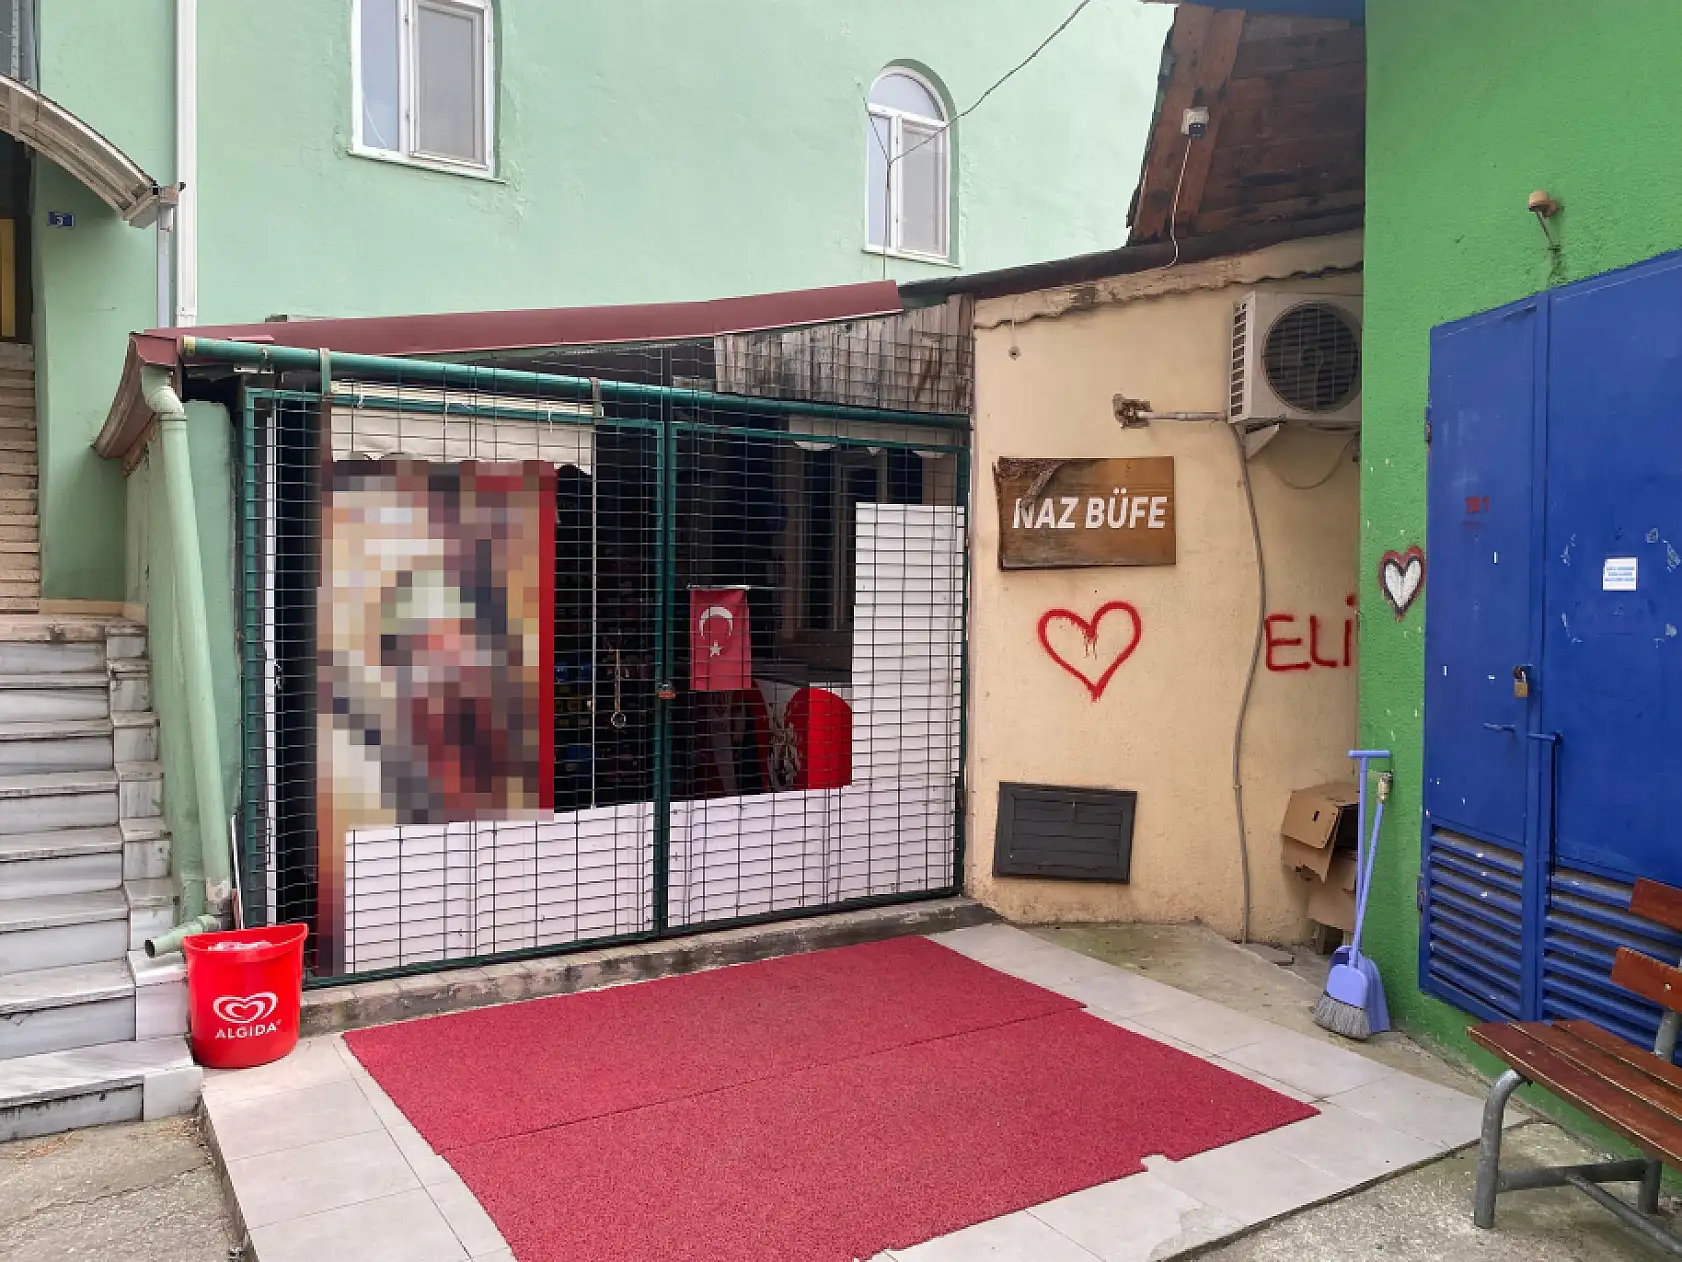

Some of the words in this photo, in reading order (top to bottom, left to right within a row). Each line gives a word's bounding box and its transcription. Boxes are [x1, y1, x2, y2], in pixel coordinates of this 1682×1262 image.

[1011, 496, 1079, 529] NAZ
[1085, 487, 1168, 529] BÜFE
[215, 1022, 277, 1040] ALGIDA
